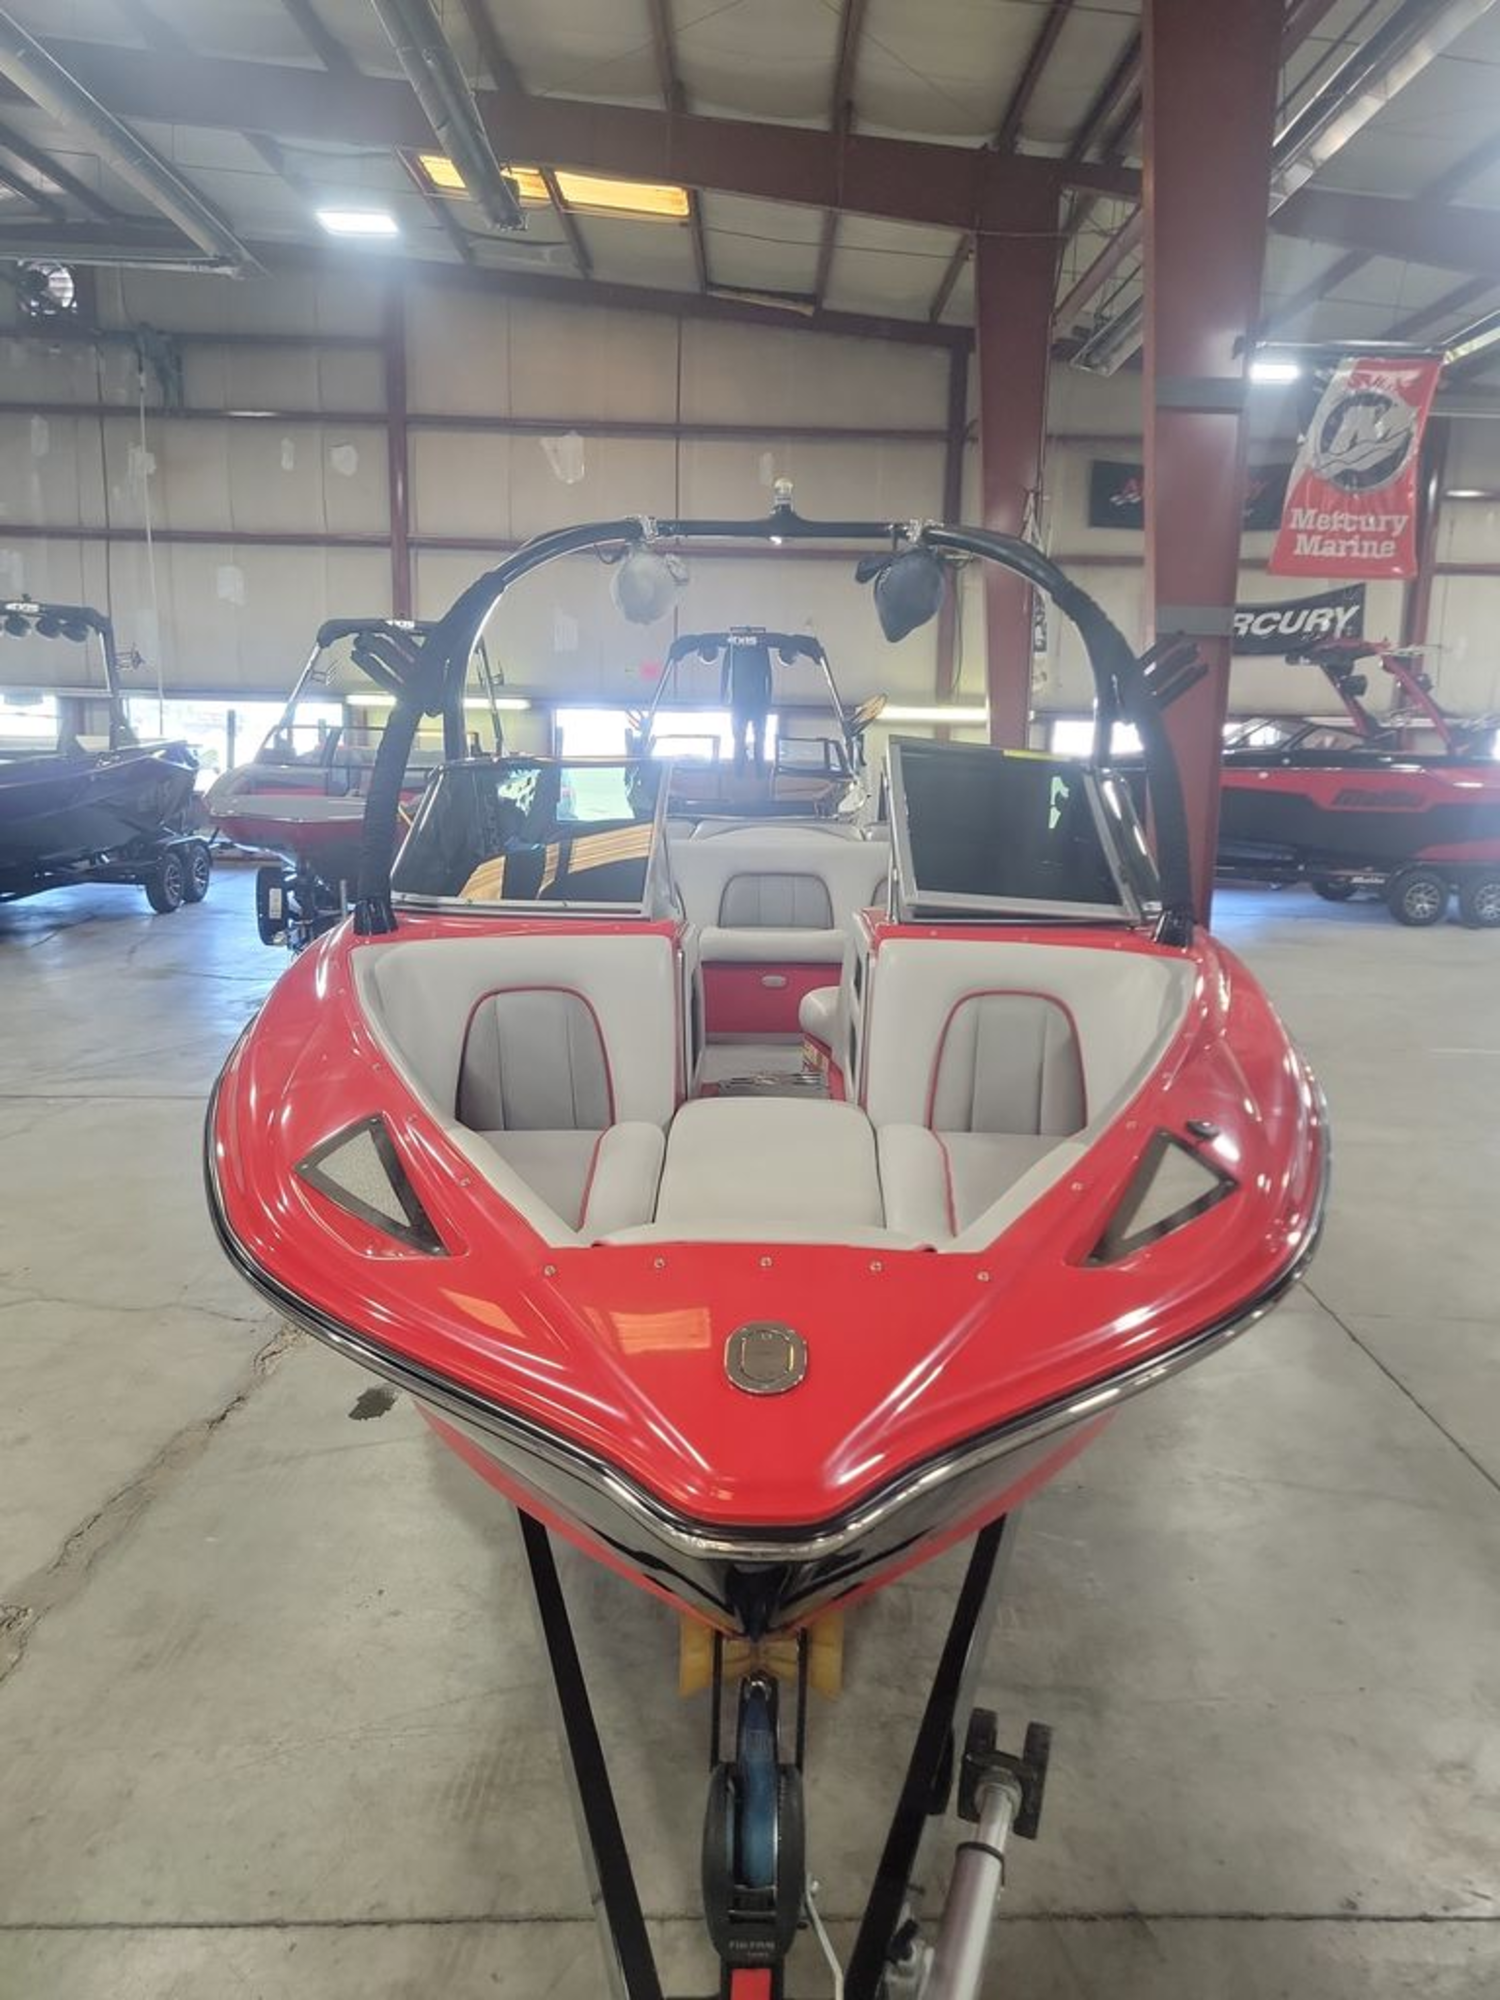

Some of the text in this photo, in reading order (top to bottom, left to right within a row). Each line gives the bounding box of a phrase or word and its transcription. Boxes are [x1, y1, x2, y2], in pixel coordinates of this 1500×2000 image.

[1290, 507, 1409, 538] Mercury
[1293, 533, 1396, 559] Marine
[1234, 605, 1360, 639] RCURY
